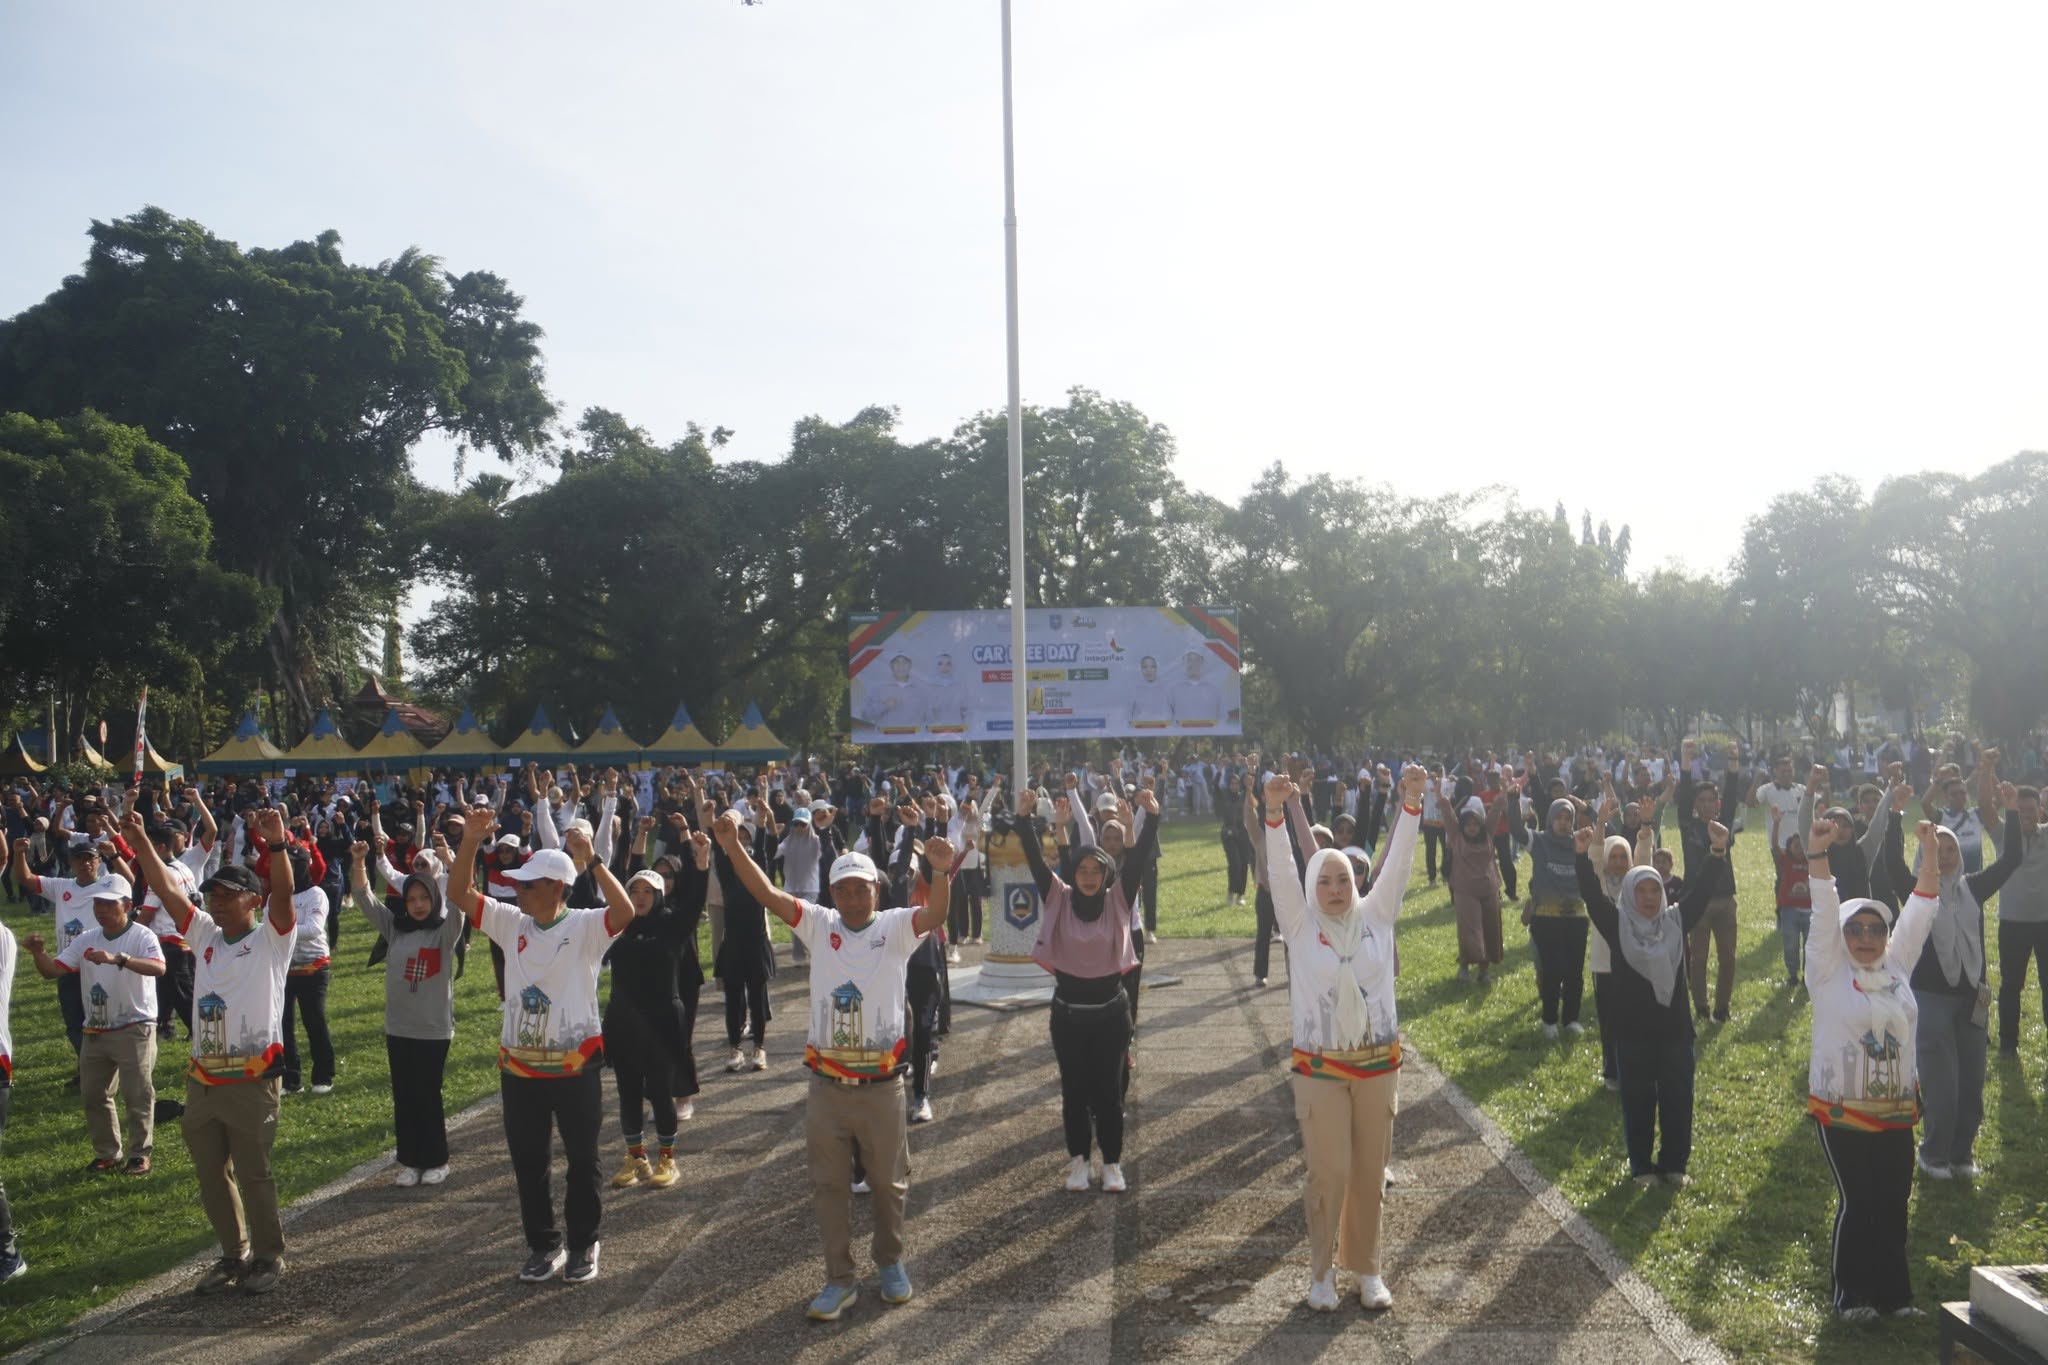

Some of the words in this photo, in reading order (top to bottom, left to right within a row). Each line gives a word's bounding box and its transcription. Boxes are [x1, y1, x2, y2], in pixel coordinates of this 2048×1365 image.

[973, 645, 1005, 663] CAR
[1007, 644, 1044, 662] EE
[1047, 643, 1079, 662] DAY
